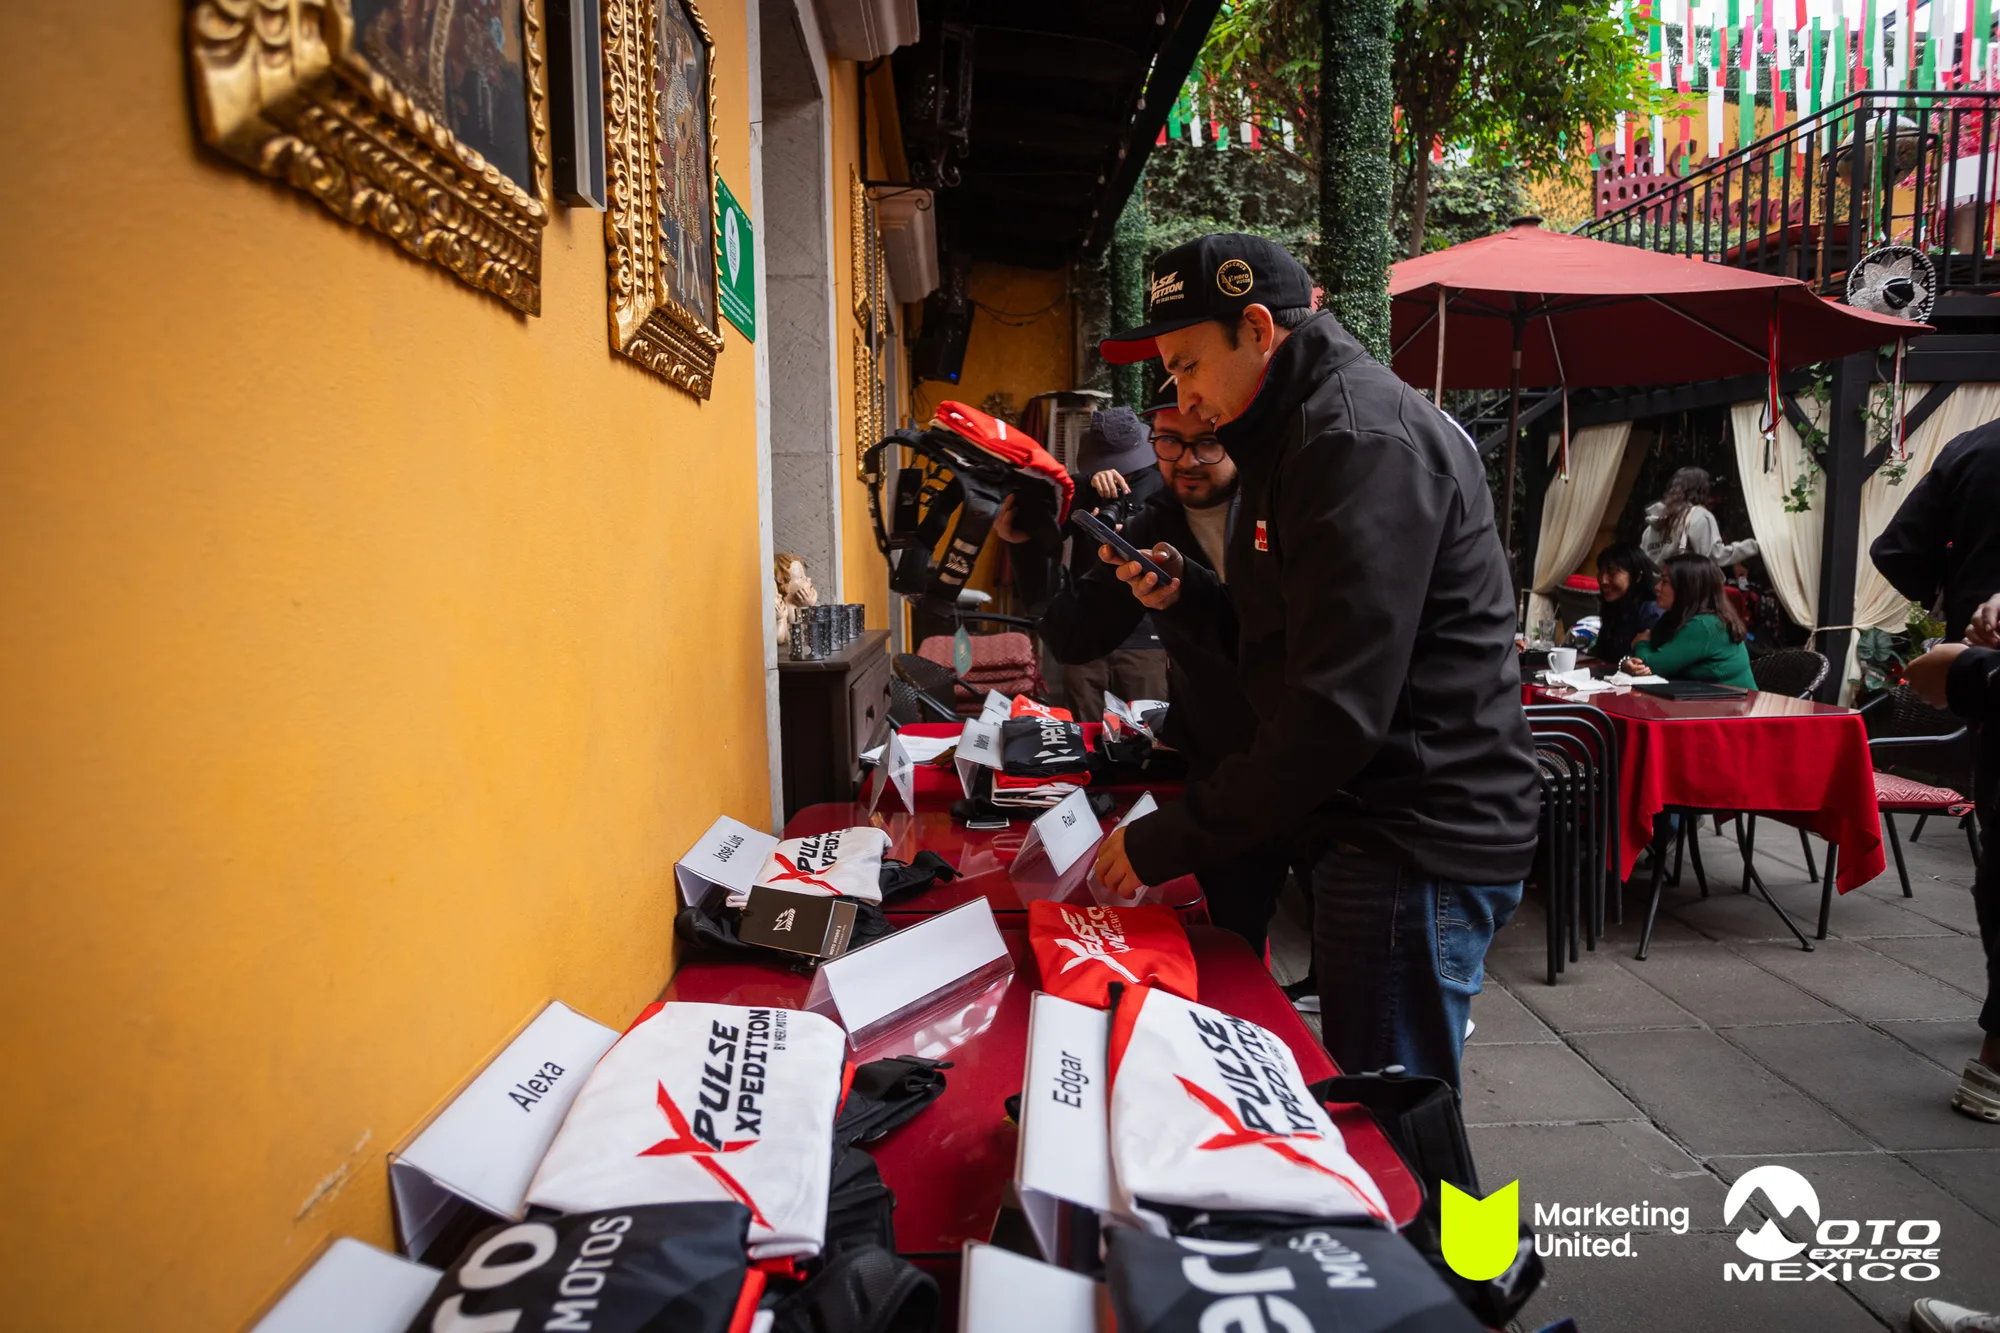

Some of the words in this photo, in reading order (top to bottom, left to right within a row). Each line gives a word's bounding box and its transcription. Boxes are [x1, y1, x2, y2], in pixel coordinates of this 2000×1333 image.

[712, 844, 735, 862] José
[723, 834, 745, 849] Luis
[507, 1059, 566, 1113] Alexa
[734, 1008, 771, 1136] XPEDITION
[1053, 1051, 1090, 1110] Edgar
[544, 1215, 634, 1332] MOTOS
